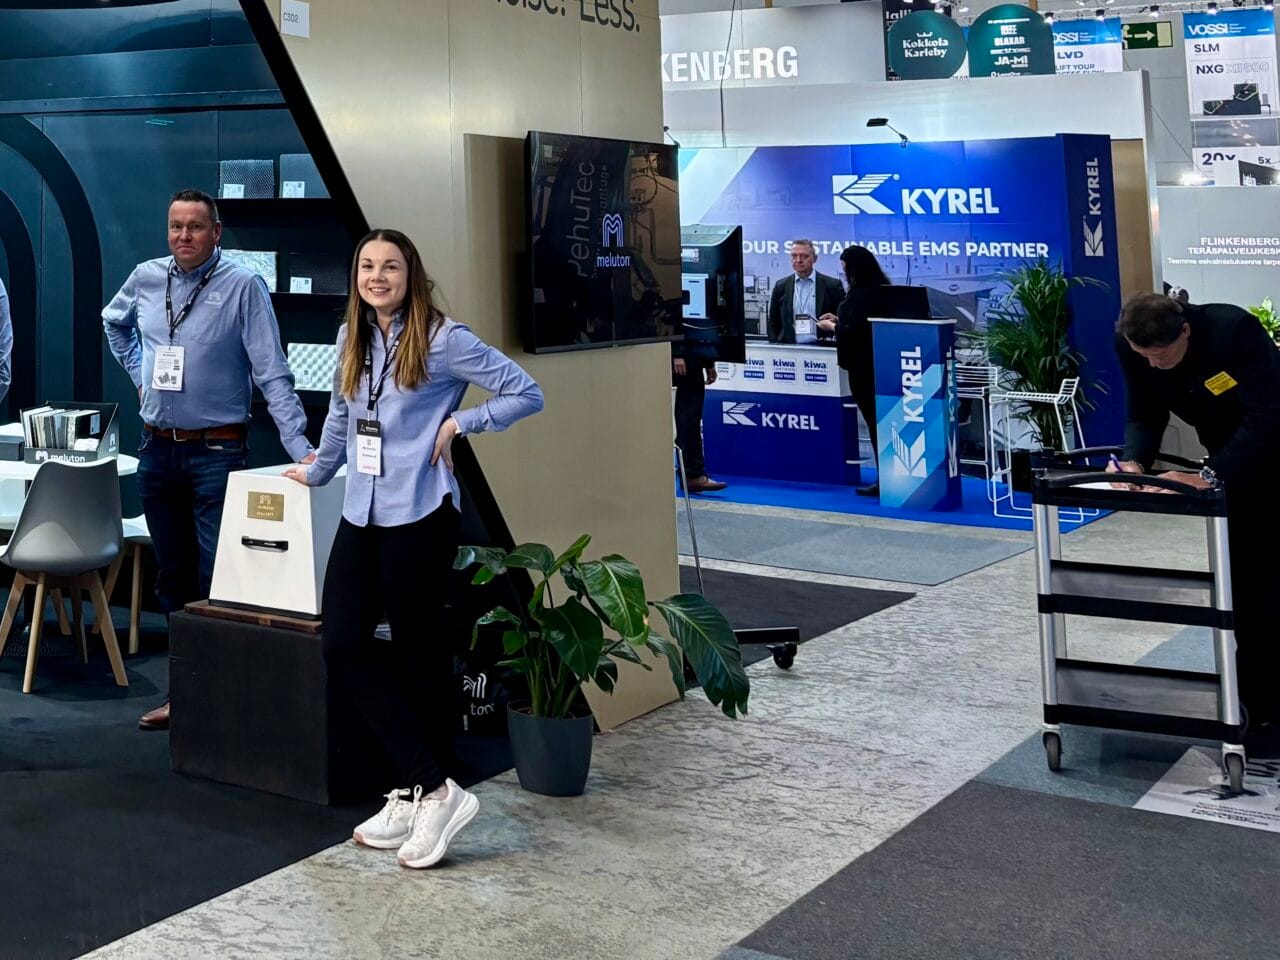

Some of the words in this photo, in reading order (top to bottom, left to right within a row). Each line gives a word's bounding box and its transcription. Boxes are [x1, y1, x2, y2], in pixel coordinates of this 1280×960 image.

[283, 12, 299, 24] C302
[1187, 23, 1228, 35] VOSSI
[1053, 32, 1079, 43] OSSI
[902, 38, 949, 49] Kokkola
[1194, 43, 1220, 53] SLM
[904, 47, 948, 58] Karleby
[1057, 51, 1084, 59] LVD
[661, 45, 799, 83] KENBERG
[1196, 64, 1224, 74] NXG
[1257, 156, 1271, 164] 5x
[1086, 157, 1102, 215] KYREL
[901, 187, 1000, 215] KYREL
[1201, 237, 1280, 245] FLINKENBERG
[743, 240, 779, 254] OUR
[784, 240, 914, 255] SSTAABLE
[919, 242, 961, 256] EMS
[966, 242, 1050, 257] PARTNER
[597, 253, 630, 267] meluton
[773, 358, 795, 367] kiwa
[804, 359, 826, 369] kiwa
[900, 346, 925, 423] KYREL
[761, 412, 820, 431] KYREL
